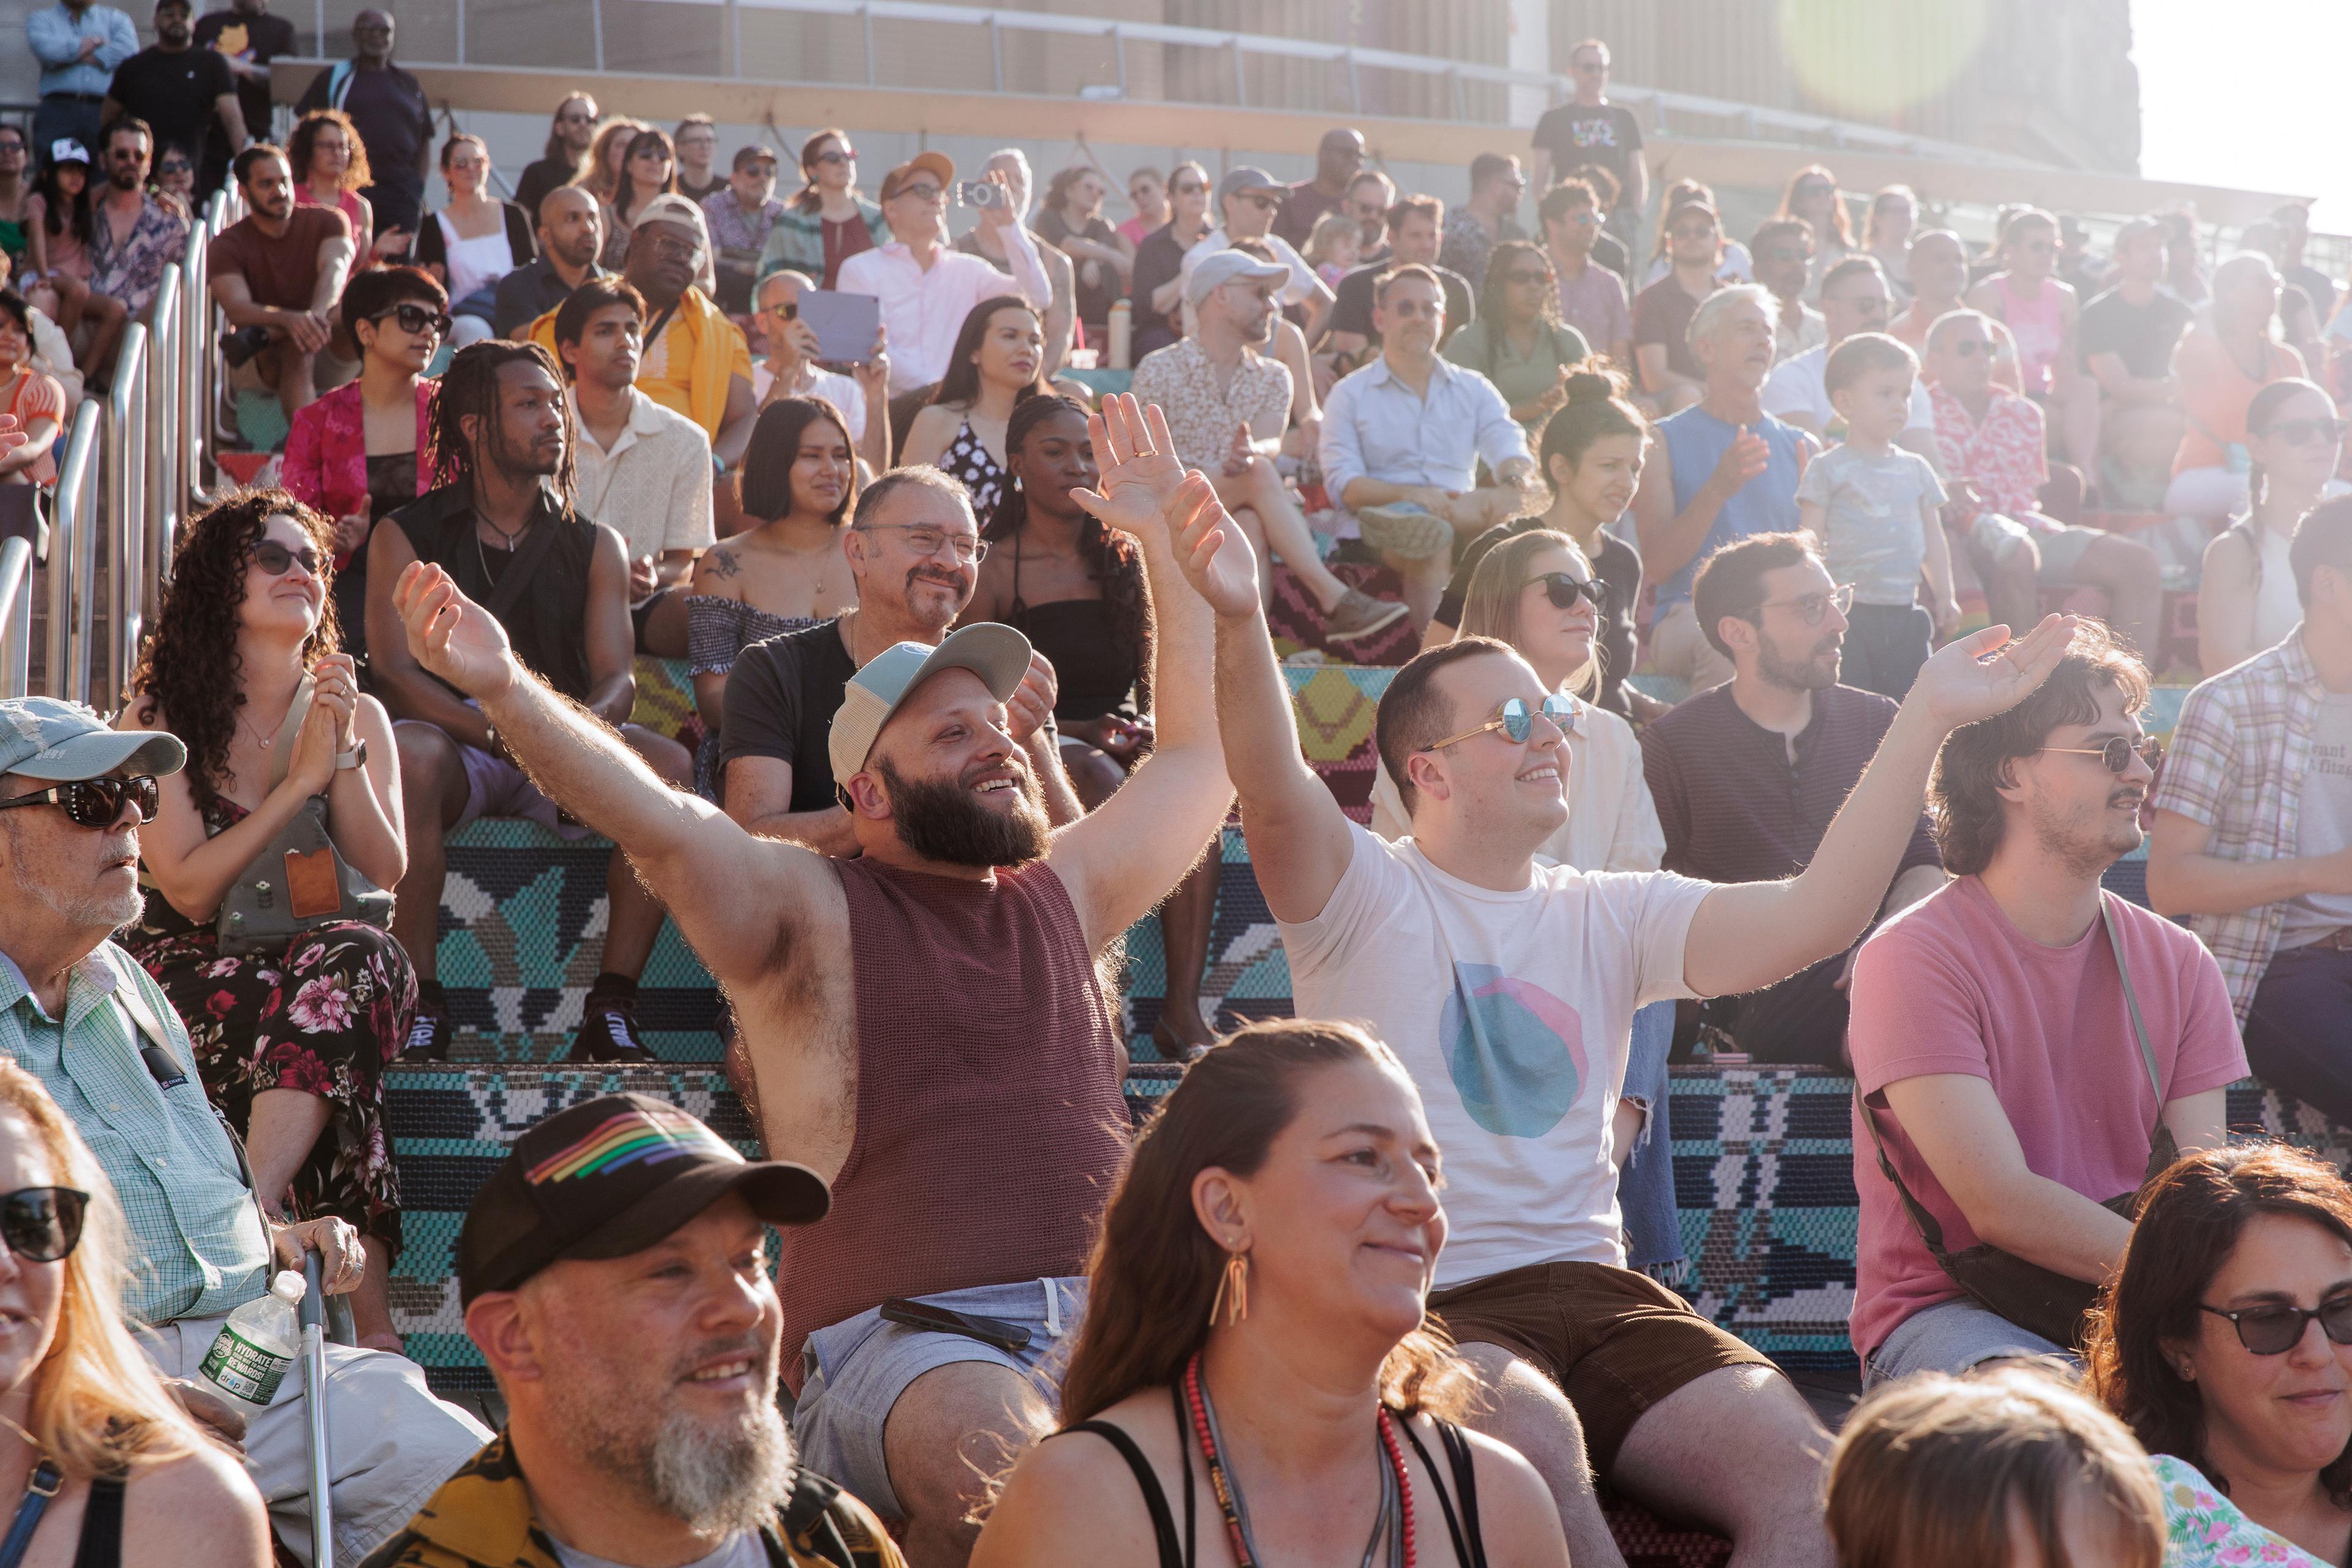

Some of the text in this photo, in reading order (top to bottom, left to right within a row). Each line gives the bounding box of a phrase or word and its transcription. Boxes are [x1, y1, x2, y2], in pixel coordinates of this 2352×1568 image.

[233, 1351, 243, 1360] YOUR
[242, 1357, 252, 1365] WAY
[235, 1342, 273, 1368] HYDRATE
[227, 1356, 265, 1381] REWARDS!
